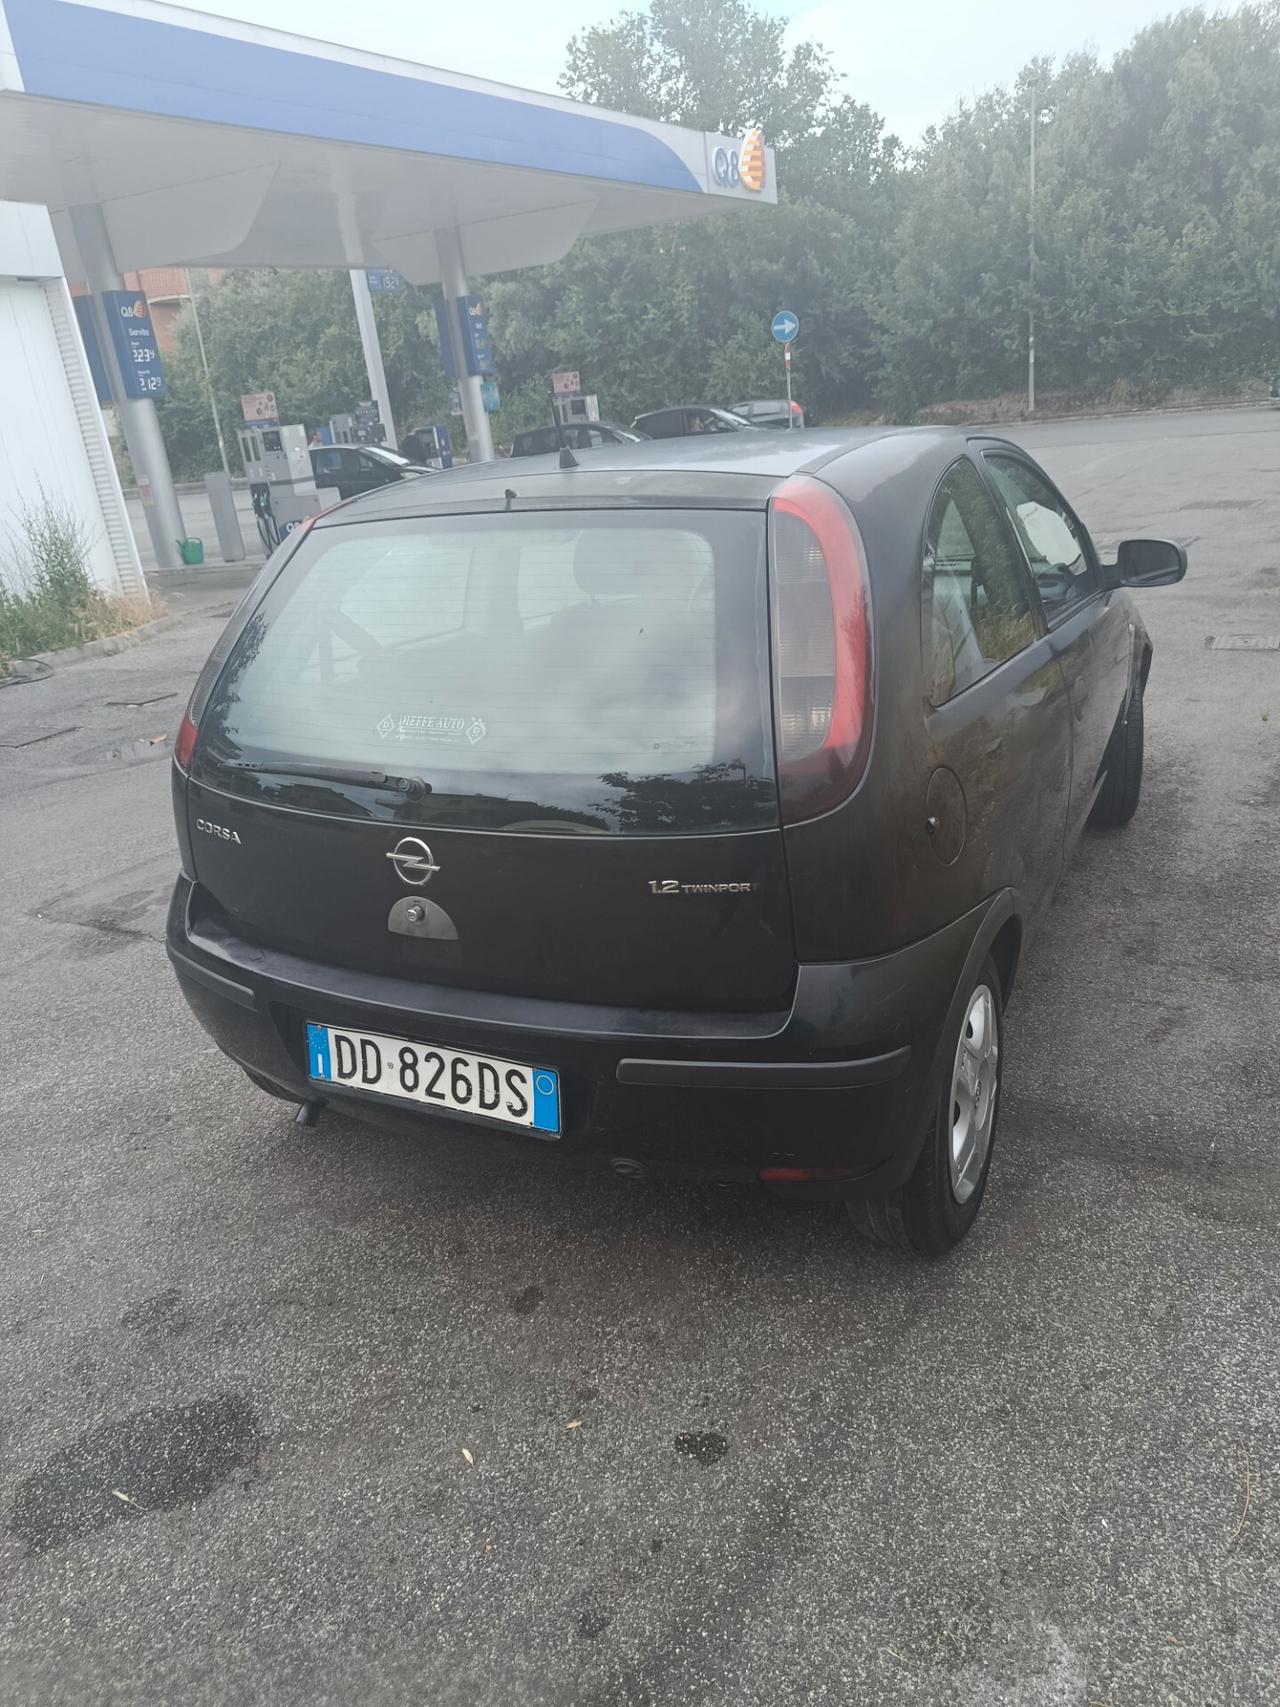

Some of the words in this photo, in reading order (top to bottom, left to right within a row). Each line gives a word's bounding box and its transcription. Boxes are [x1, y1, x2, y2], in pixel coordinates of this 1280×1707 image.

[712, 145, 739, 188] Q8
[121, 306, 134, 318] Q8
[435, 718, 465, 730] AUTO
[196, 818, 242, 845] CORSA
[647, 880, 680, 894] 1.2
[334, 1034, 382, 1085] DD
[398, 1046, 529, 1118] 826DS
